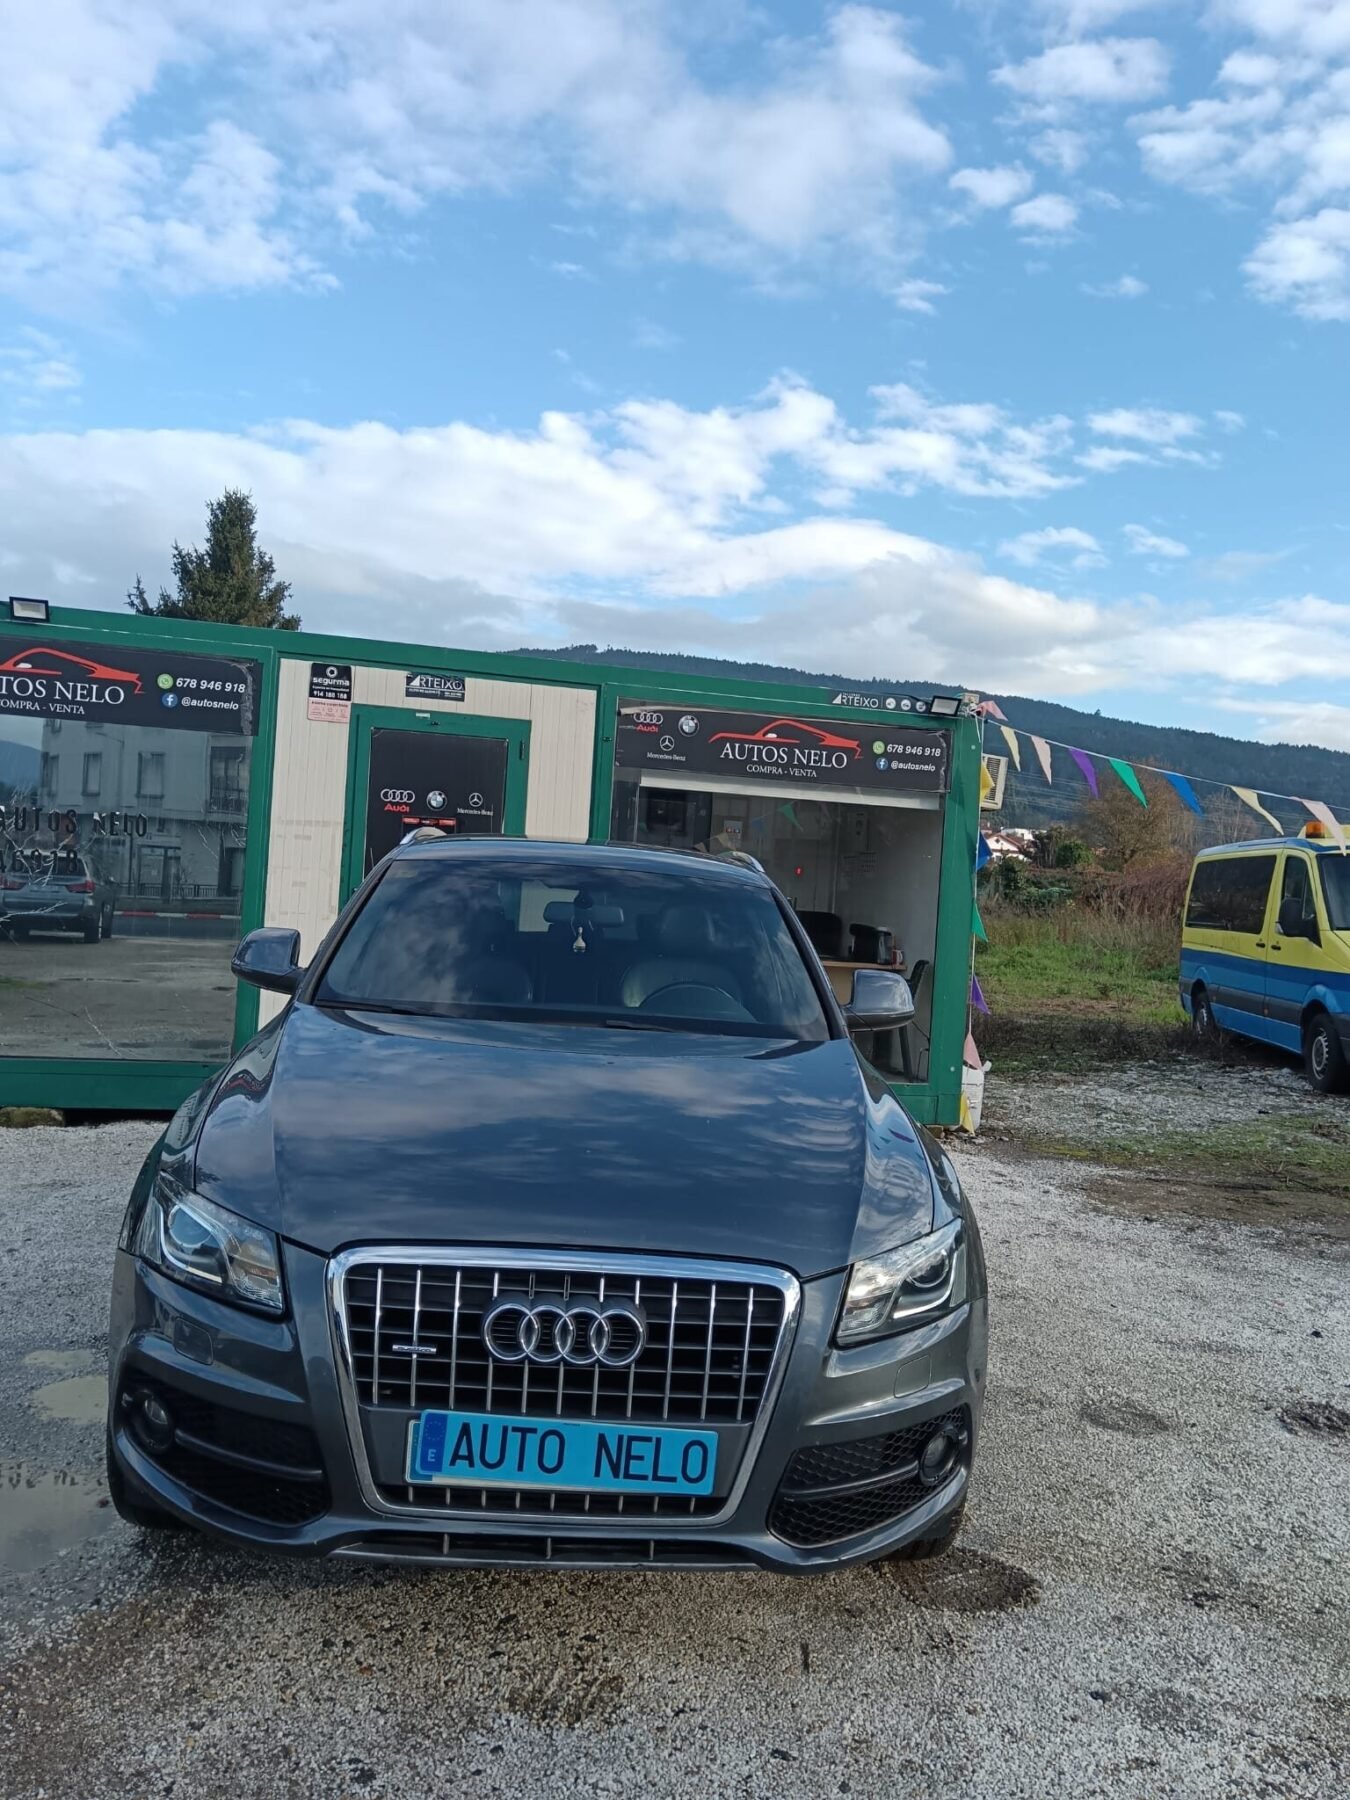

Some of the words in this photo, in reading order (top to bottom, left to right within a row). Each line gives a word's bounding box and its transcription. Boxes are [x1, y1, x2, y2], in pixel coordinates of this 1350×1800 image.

[176, 677, 197, 689] 678
[200, 680, 222, 691] 946
[224, 682, 246, 693] 918
[312, 677, 350, 686] segurma
[54, 681, 125, 705] NELO
[0, 699, 40, 711] OMPRA
[48, 703, 86, 715] VENTA
[181, 696, 239, 710] @autosnelo
[832, 692, 879, 709] ARTEIXO
[637, 724, 659, 733] Audi
[720, 742, 788, 764] AUTOS
[792, 748, 848, 769] NELO
[886, 743, 903, 754] 678
[905, 745, 924, 756] 946
[924, 747, 941, 757] 918
[746, 764, 783, 775] COMPRA
[789, 767, 817, 778] VENTA
[890, 760, 936, 772] @autosnelo
[384, 802, 410, 813] Audi
[93, 811, 147, 837] NELO
[427, 1448, 437, 1462] E
[448, 1422, 566, 1475] AUTO
[593, 1432, 709, 1485] NELO
